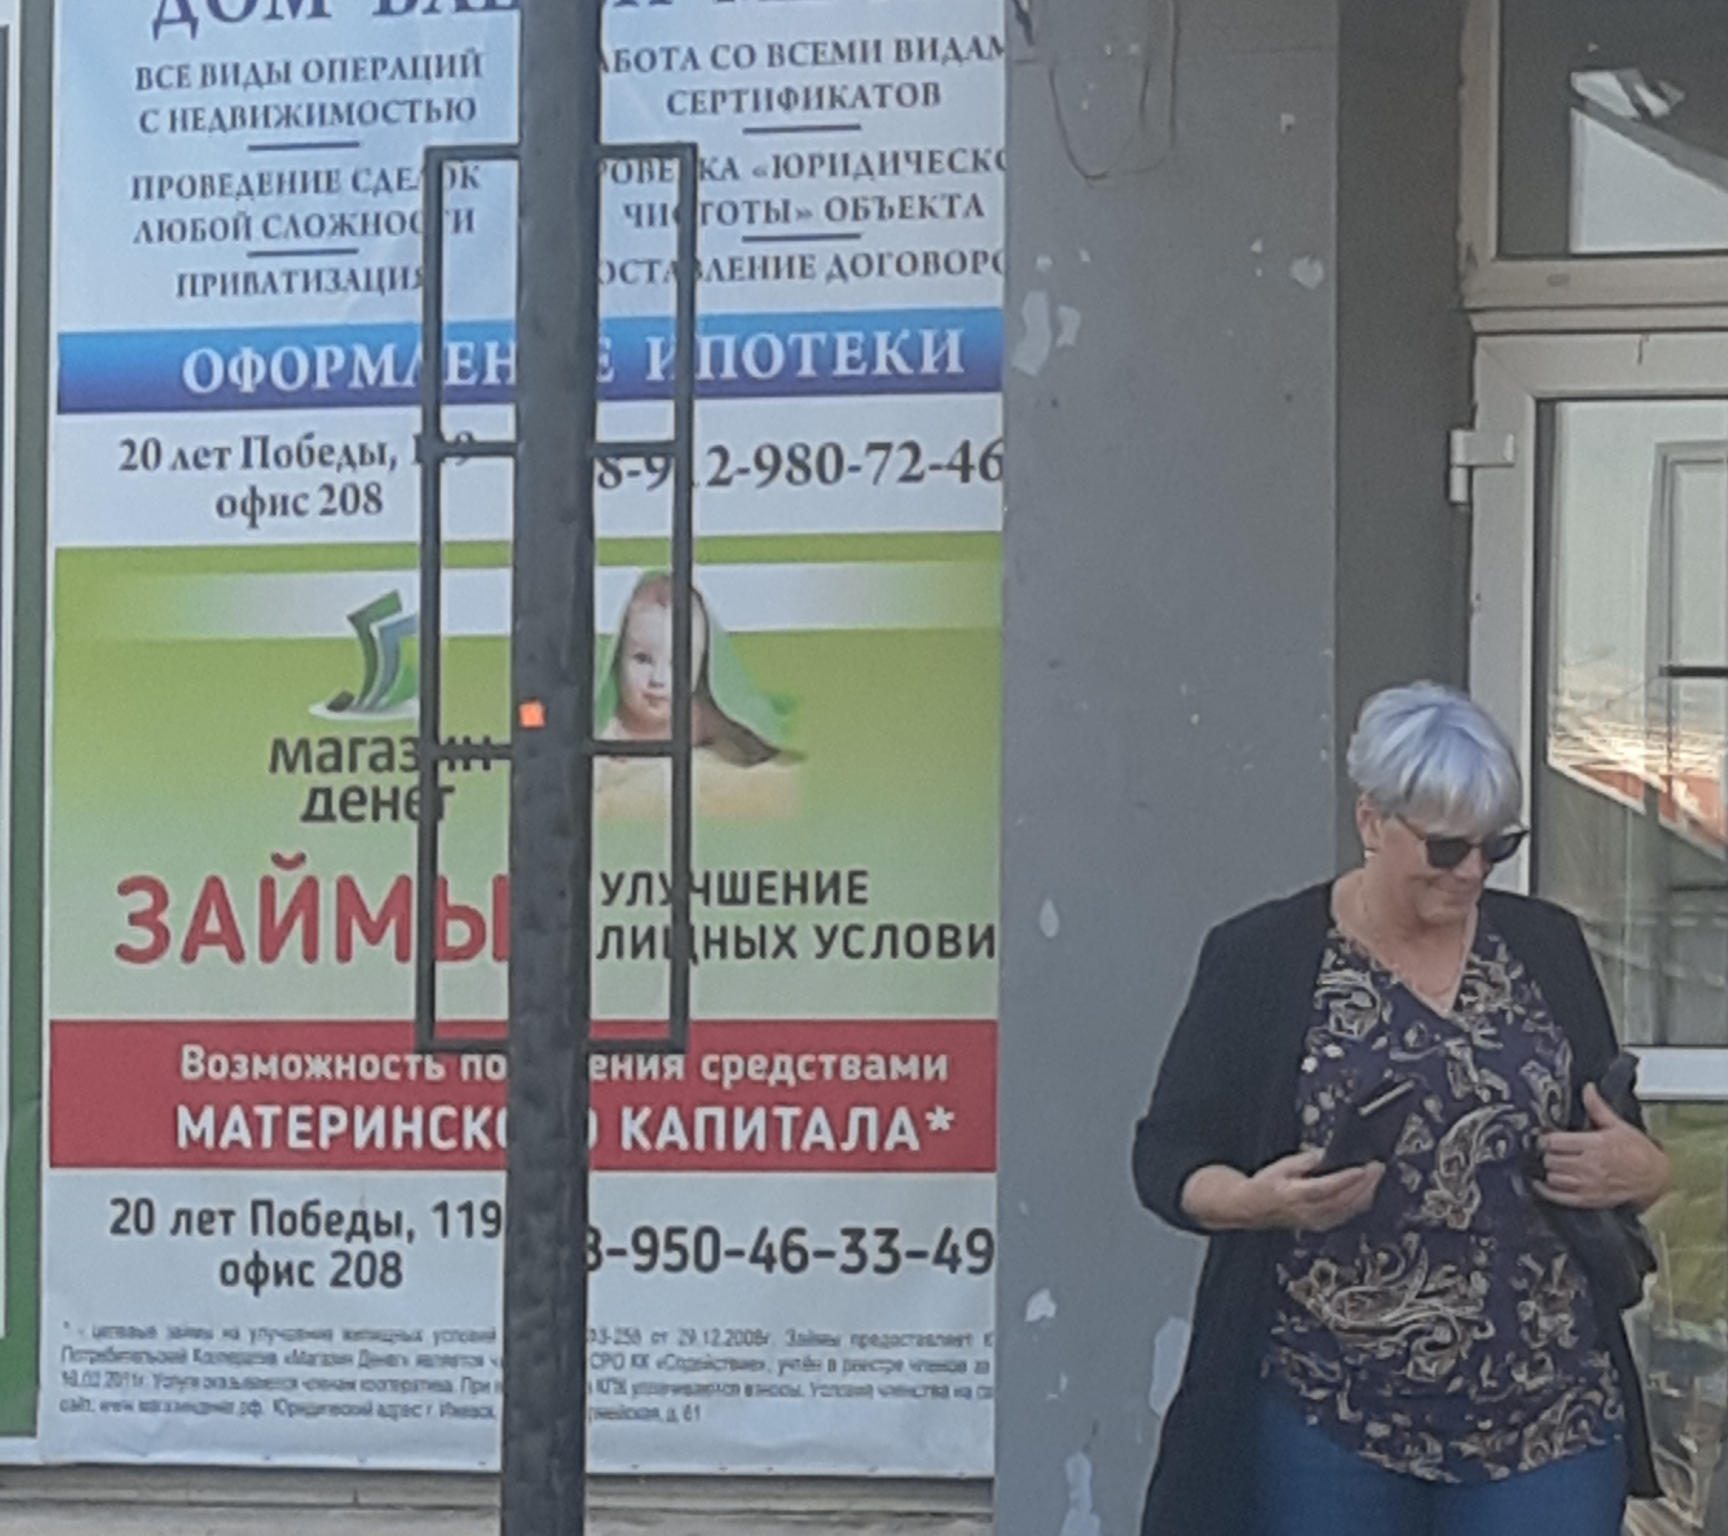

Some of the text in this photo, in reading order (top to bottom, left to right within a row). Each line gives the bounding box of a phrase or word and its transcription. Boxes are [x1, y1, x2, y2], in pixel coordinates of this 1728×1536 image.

[135, 46, 484, 94] ВСЕ ВИДЫ ОПЕРАЦИЙ
[602, 44, 700, 74] БОТА
[710, 42, 756, 71] СО
[767, 39, 889, 69] ВСЕМИ
[138, 96, 477, 136] С НЕДВИЖИМОСТЬЮ
[666, 82, 942, 117] СЕРТИФИКАТОВ
[130, 168, 341, 202] ПРОВЕДЕНИЕ
[824, 192, 985, 223] ОБЪЕКТА
[132, 210, 252, 244] ЛЮБОЙ
[119, 437, 162, 473] 20
[169, 445, 231, 472] лет
[240, 431, 397, 473] Победы,
[596, 437, 1003, 492] 8-92-980-72-46
[216, 482, 384, 530] офис 208
[115, 852, 511, 965] ЗАЙМЫ
[181, 1043, 446, 1081] Возможность
[702, 1052, 949, 1090] средствами
[109, 1197, 502, 1244] 20 лет Победы, 119
[587, 1225, 995, 1275] 8-950-46-33-49
[219, 1250, 403, 1298] офис 208
